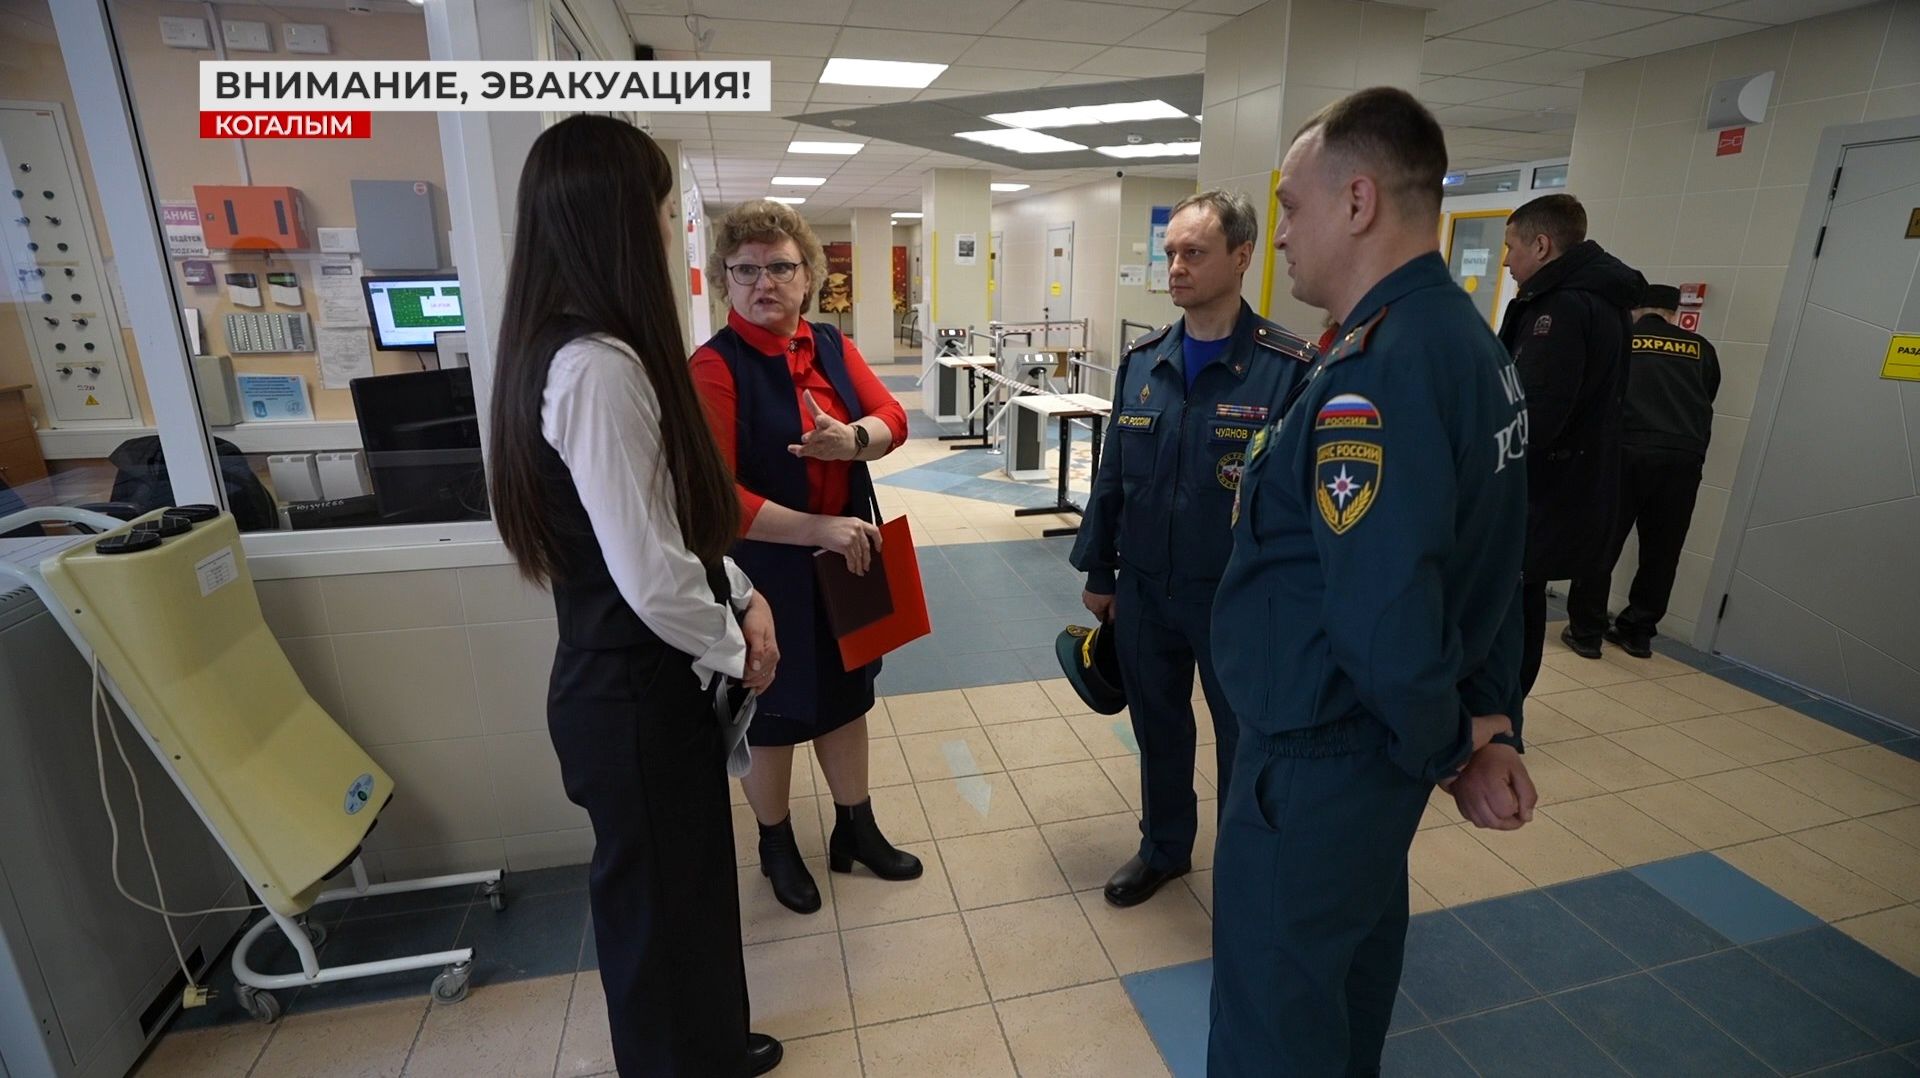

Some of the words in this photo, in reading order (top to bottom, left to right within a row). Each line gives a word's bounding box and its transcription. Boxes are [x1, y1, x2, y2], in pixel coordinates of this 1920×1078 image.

[1632, 338, 1697, 355] ОХРАНА
[1324, 416, 1368, 426] РОССИЯ
[1215, 427, 1249, 439] ЧУДНОВ
[1336, 444, 1380, 461] РОССИИ
